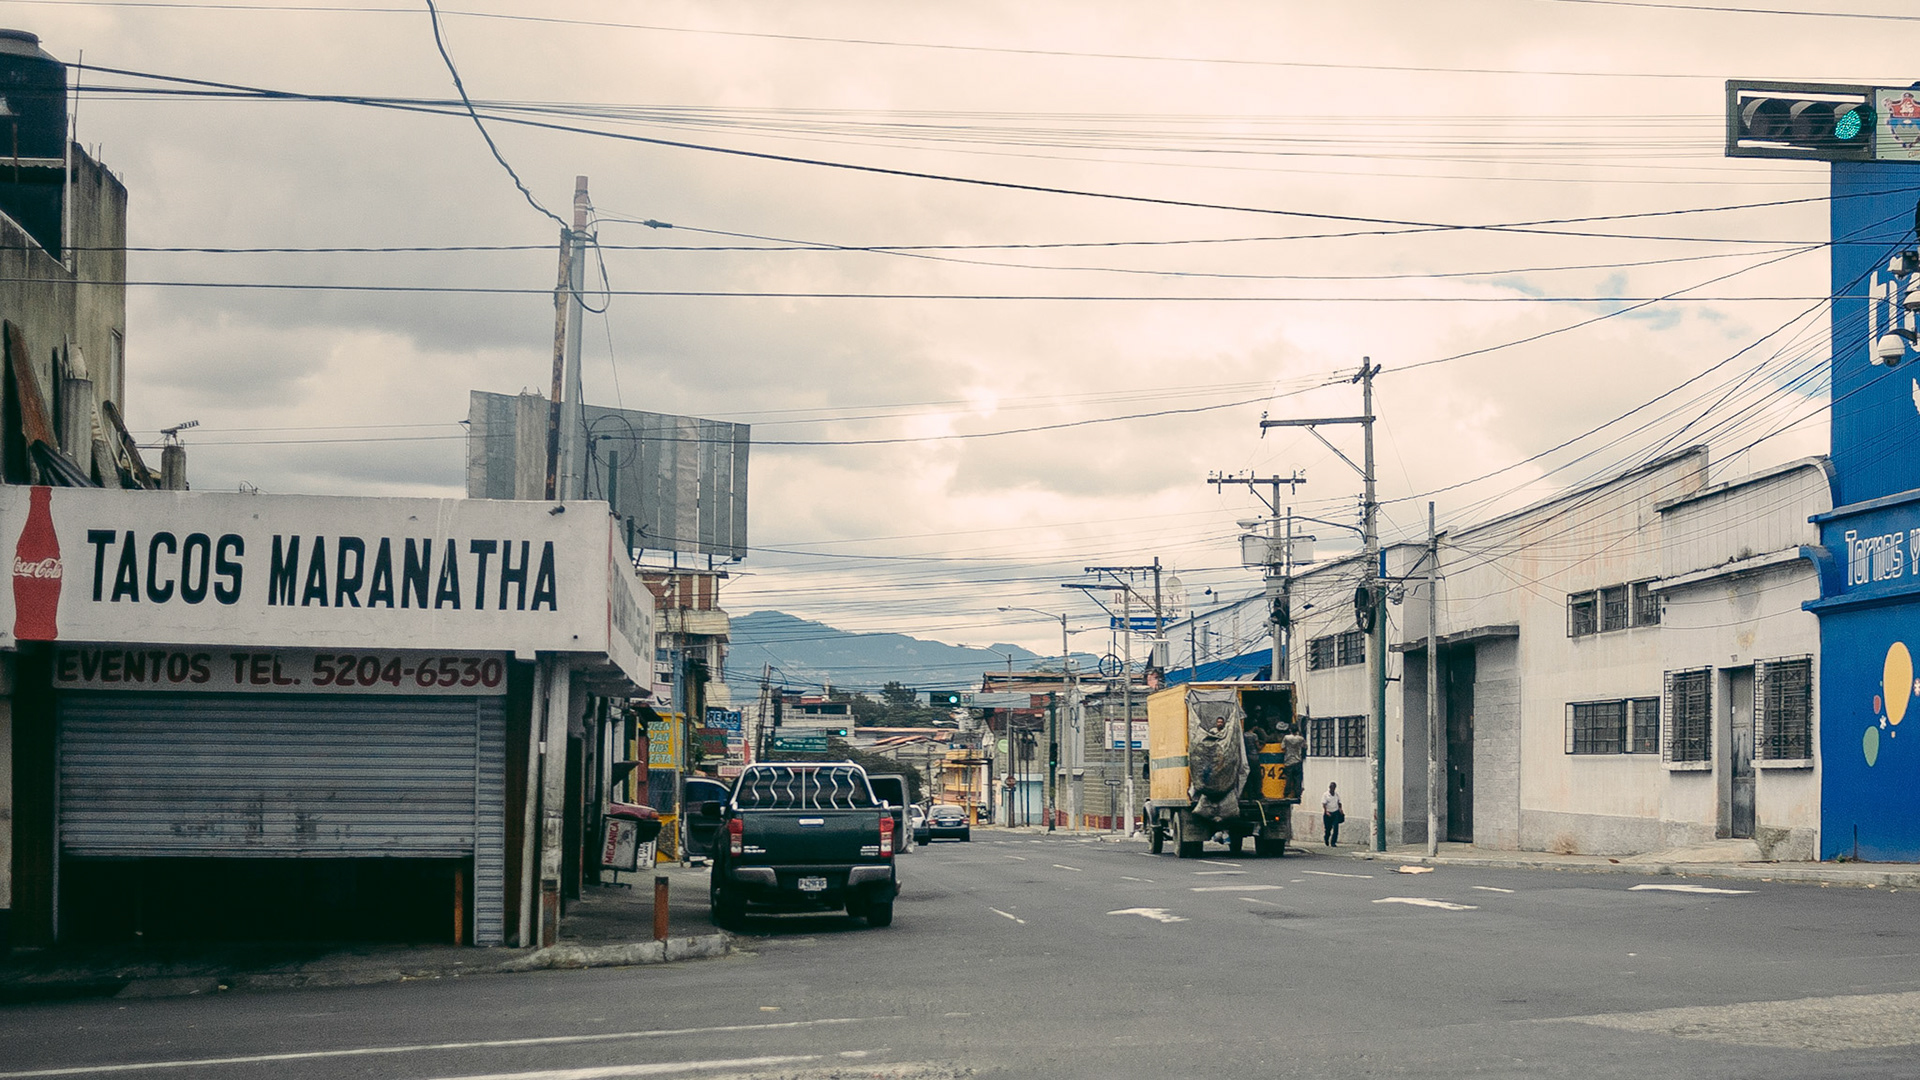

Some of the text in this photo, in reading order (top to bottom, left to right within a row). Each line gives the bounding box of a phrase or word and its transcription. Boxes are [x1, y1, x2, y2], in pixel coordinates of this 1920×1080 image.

[87, 529, 245, 605] TACOS
[267, 534, 558, 611] MARANATHA
[1845, 529, 1904, 586] Tornos
[56, 650, 503, 688] EVENTOS TEL. 5204-6530
[604, 821, 620, 865] MECANICA
